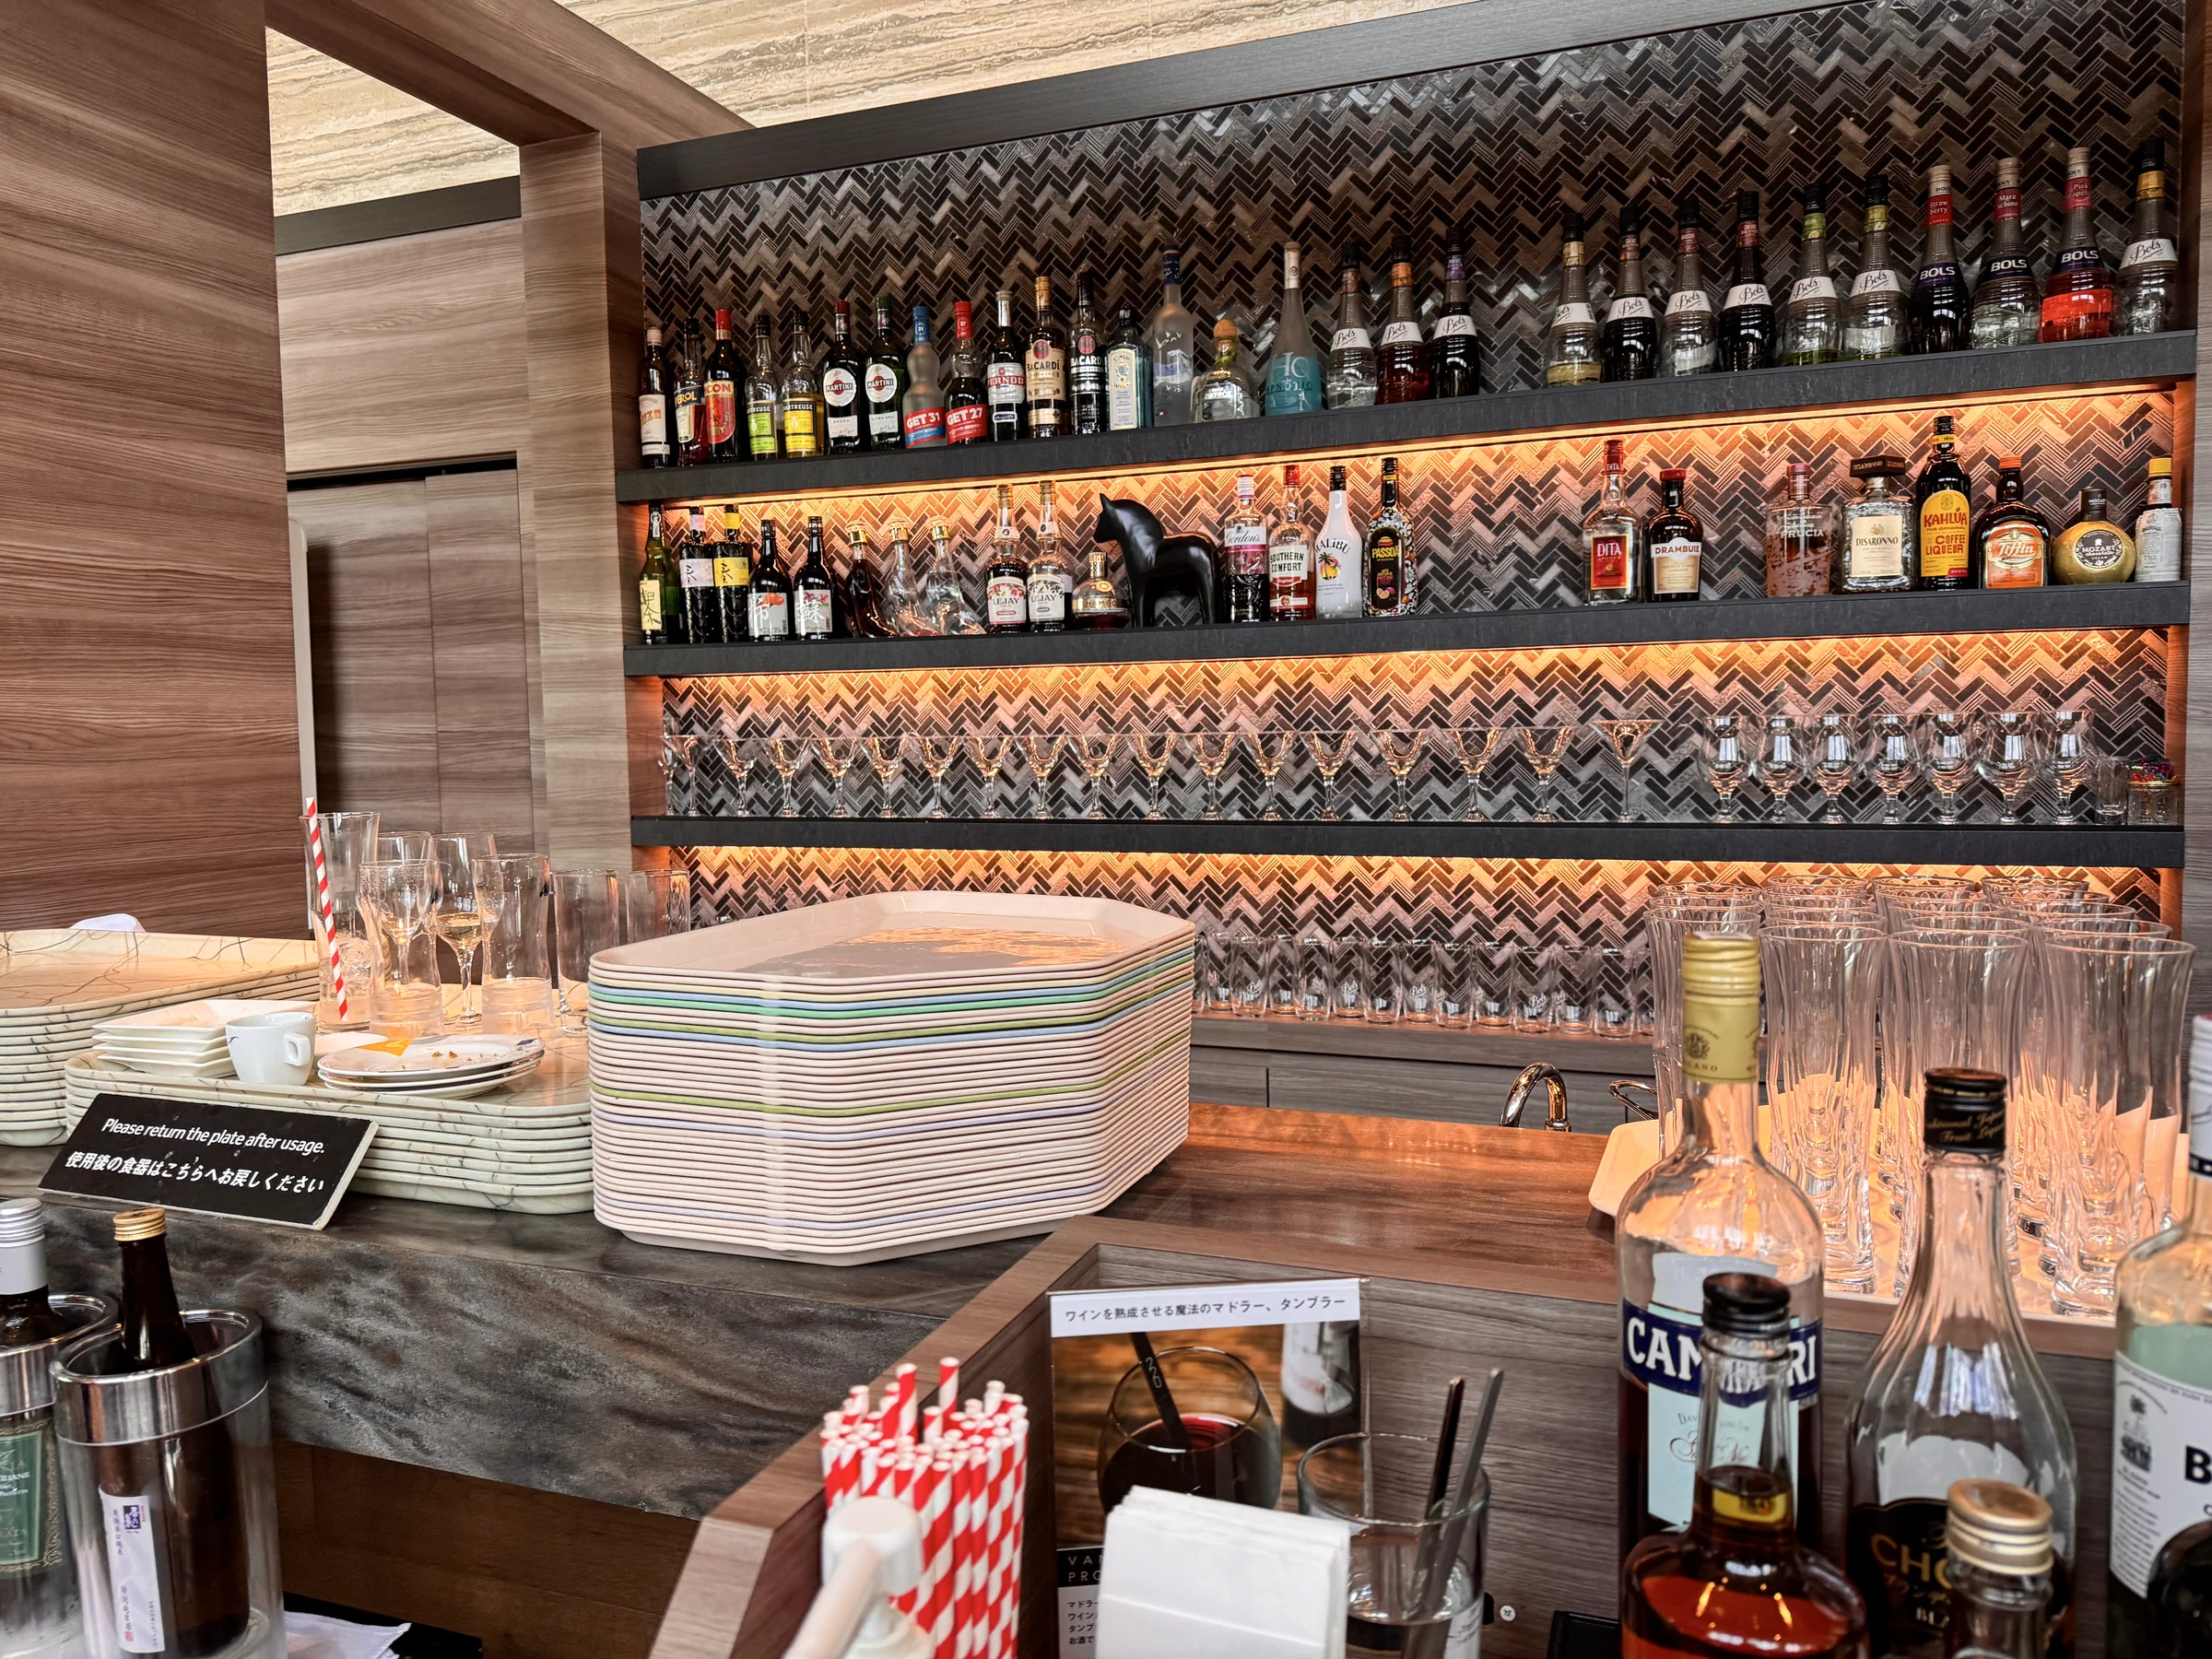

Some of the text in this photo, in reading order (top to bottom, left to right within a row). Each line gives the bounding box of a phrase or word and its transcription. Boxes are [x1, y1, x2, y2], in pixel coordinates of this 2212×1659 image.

[2061, 250, 2099, 265] BOLS
[2130, 240, 2162, 263] Bols
[1920, 266, 1956, 280] BOLS
[1991, 259, 2028, 273] BOLS
[1794, 278, 1818, 299] Bols
[1859, 271, 1888, 293] Bols
[1676, 292, 1700, 312] Bols
[1739, 286, 1764, 305] Bols
[1618, 298, 1642, 317] Bols
[1385, 324, 1406, 342] Bols
[1442, 316, 1466, 335] Bols
[1335, 328, 1357, 347] Bols
[826, 382, 853, 393] MARTINI
[867, 379, 894, 389] MARTINI
[906, 411, 940, 429] GET 31
[947, 407, 983, 426] GET 27
[1924, 507, 1968, 527] KAHLÚA
[1855, 536, 1899, 547] DISARONNO
[1936, 535, 1966, 545] COFFEE
[1270, 552, 1304, 563] SOUTHERN
[1597, 543, 1621, 558] DITA
[1655, 545, 1700, 554] DRAMBUIE
[1925, 544, 1964, 555] LIQUEUR
[1998, 541, 2035, 558] Tiffin
[2081, 545, 2116, 553] MOZART
[1271, 562, 1302, 572] COMFORT
[993, 597, 1020, 606] LEJAY
[1031, 594, 1057, 603] LEJAY
[100, 1117, 325, 1156] Please return the plate after usage.
[65, 1150, 324, 1194] 使用後の食器はこちらへお戻しください
[1065, 1295, 1346, 1323] ワインを熟成させる魔法のマドラー、タンブラー
[1628, 1317, 1817, 1387] CAMRI
[1068, 1612, 1098, 1621] ワイン
